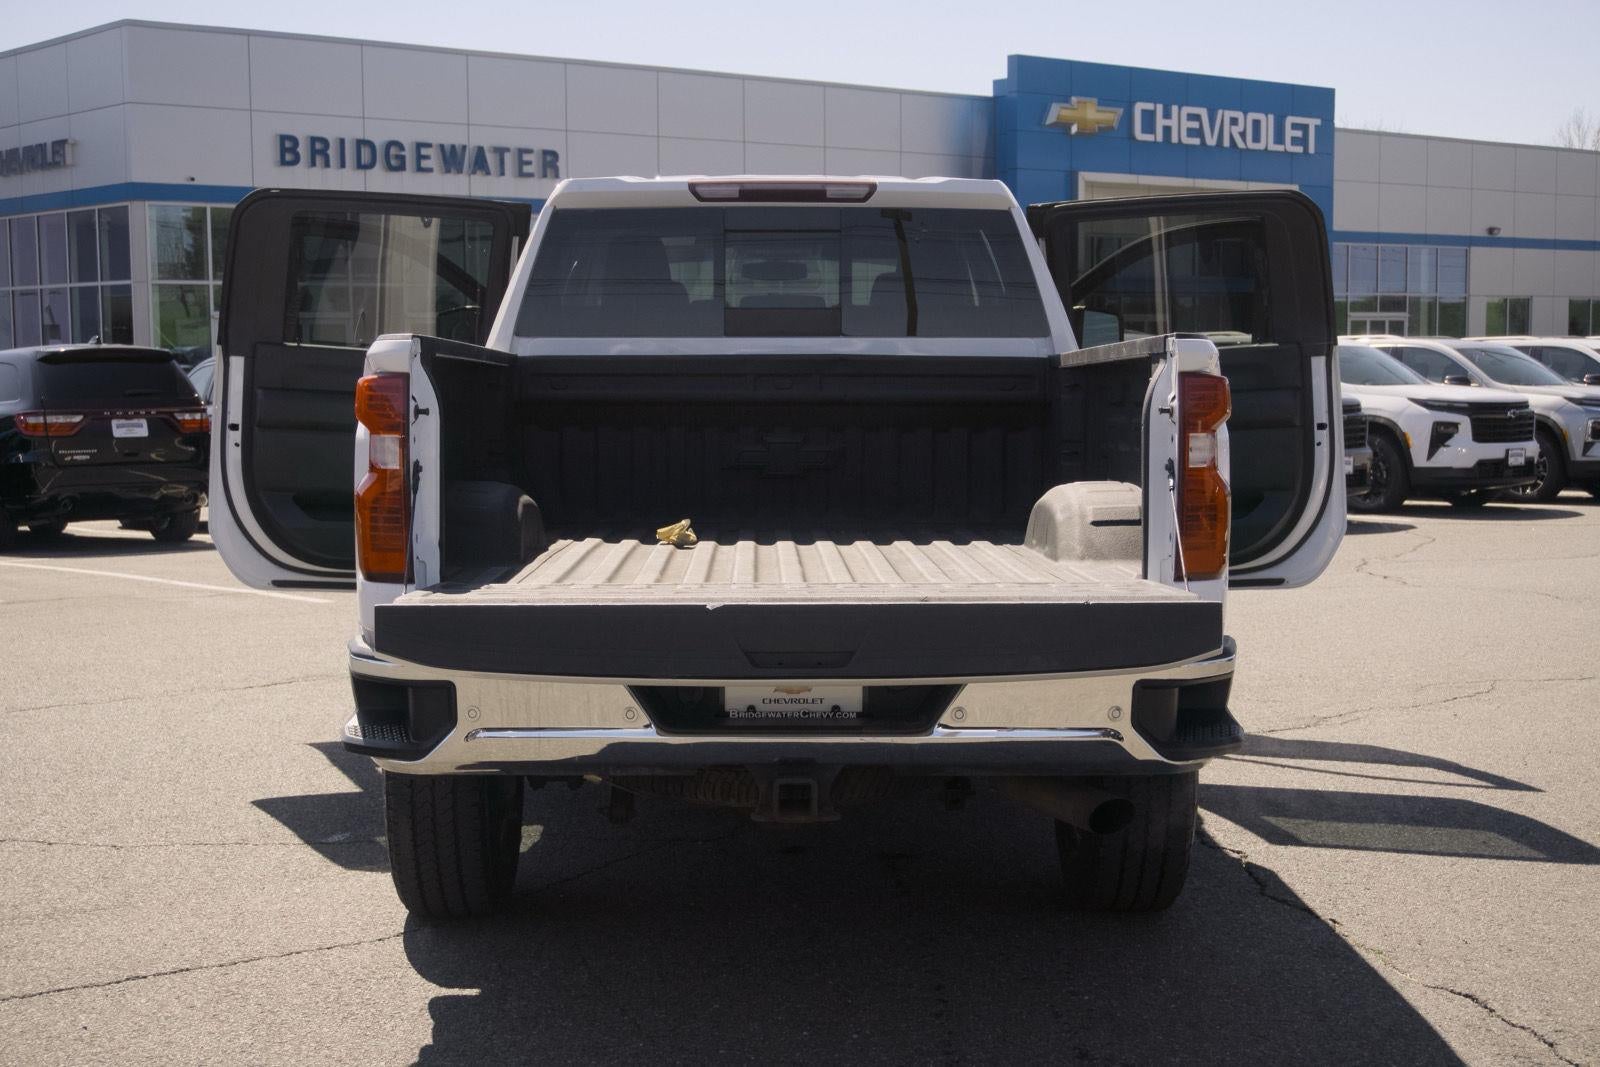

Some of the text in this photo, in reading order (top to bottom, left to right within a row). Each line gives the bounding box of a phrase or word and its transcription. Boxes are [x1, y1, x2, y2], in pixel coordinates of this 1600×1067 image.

[1133, 101, 1321, 154] CHEVROLET
[0, 138, 73, 176] HEVROLET
[278, 133, 560, 179] BRIDGEWATER
[762, 697, 825, 705] CHEVROLET
